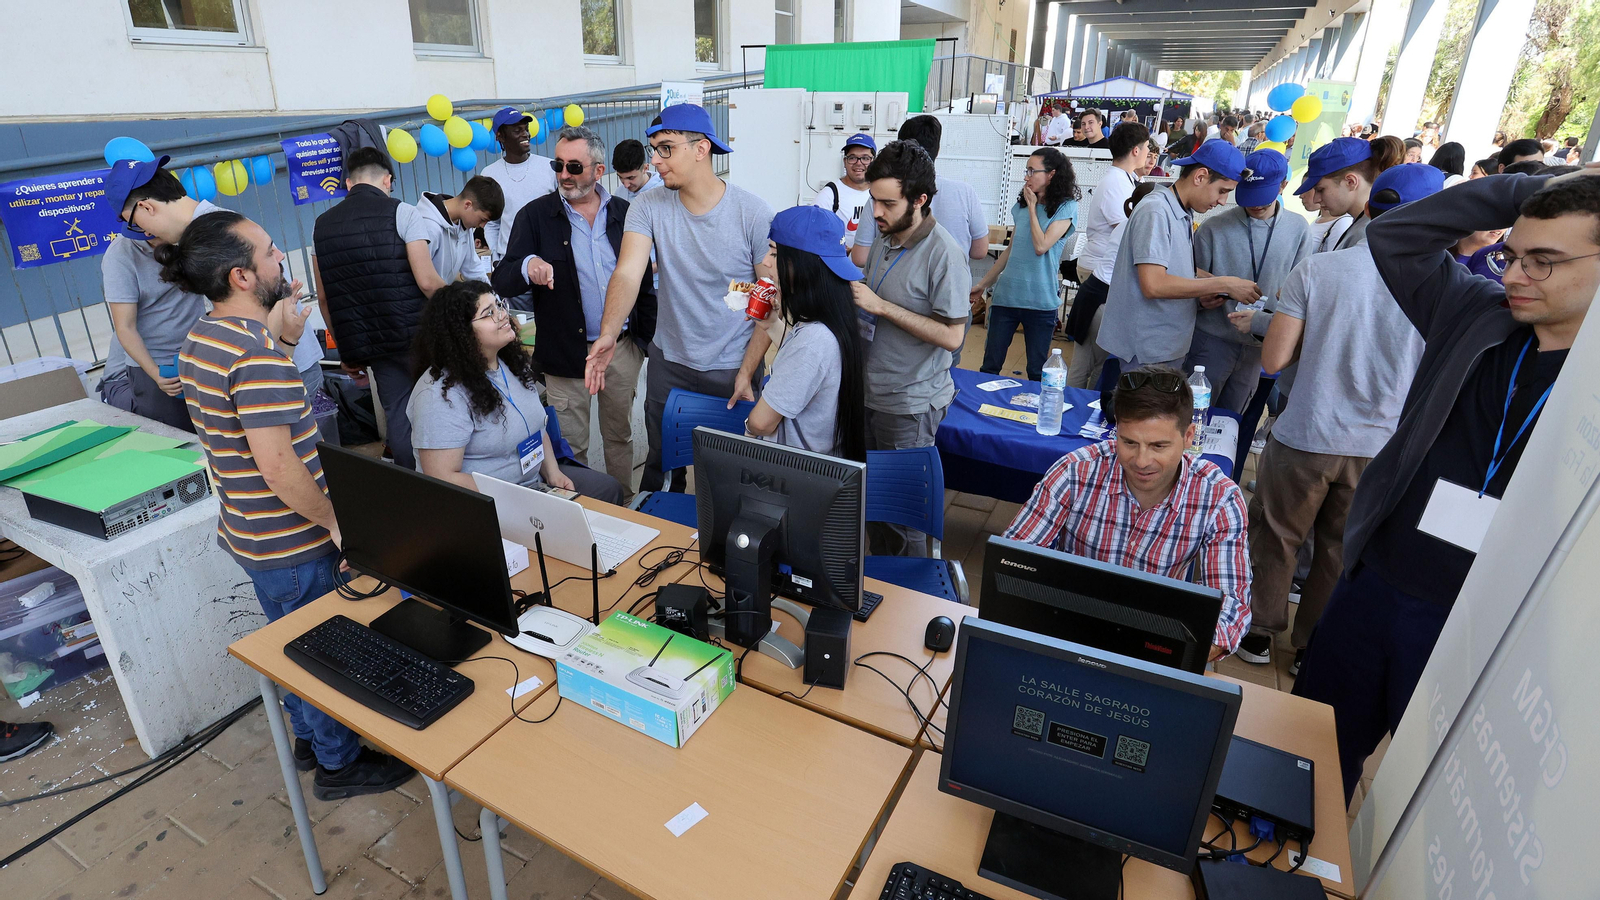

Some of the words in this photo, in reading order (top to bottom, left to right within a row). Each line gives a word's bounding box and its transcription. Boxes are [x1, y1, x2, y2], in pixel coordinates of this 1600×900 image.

[295, 140, 311, 148] Todo
[296, 150, 317, 159] quisiste
[318, 147, 332, 155] saber
[302, 168, 325, 176] atreviste
[15, 182, 57, 196] ¿Quieres
[58, 178, 96, 190] aprender
[8, 198, 44, 208] utilizar,
[45, 194, 76, 204] montar
[77, 192, 83, 201] y
[38, 202, 96, 217] dispositivos?
[740, 469, 790, 496] DELL
[530, 516, 544, 530] hp
[1000, 558, 1037, 572] lenovo
[616, 613, 649, 629] TP-LINK
[573, 647, 592, 657] Router
[1078, 656, 1106, 669] lenovo
[1021, 675, 1037, 685] LA
[1040, 680, 1080, 697] SALLE
[1084, 692, 1150, 717] SAGRADO
[1018, 685, 1080, 709] CORAZÓN
[1084, 704, 1102, 715] DE
[1106, 710, 1150, 728] JESÚS
[1056, 732, 1078, 742] ENTER
[1079, 739, 1097, 748] PARA
[1057, 727, 1089, 740] PRESIONA
[1060, 739, 1091, 751] EMPEZAR
